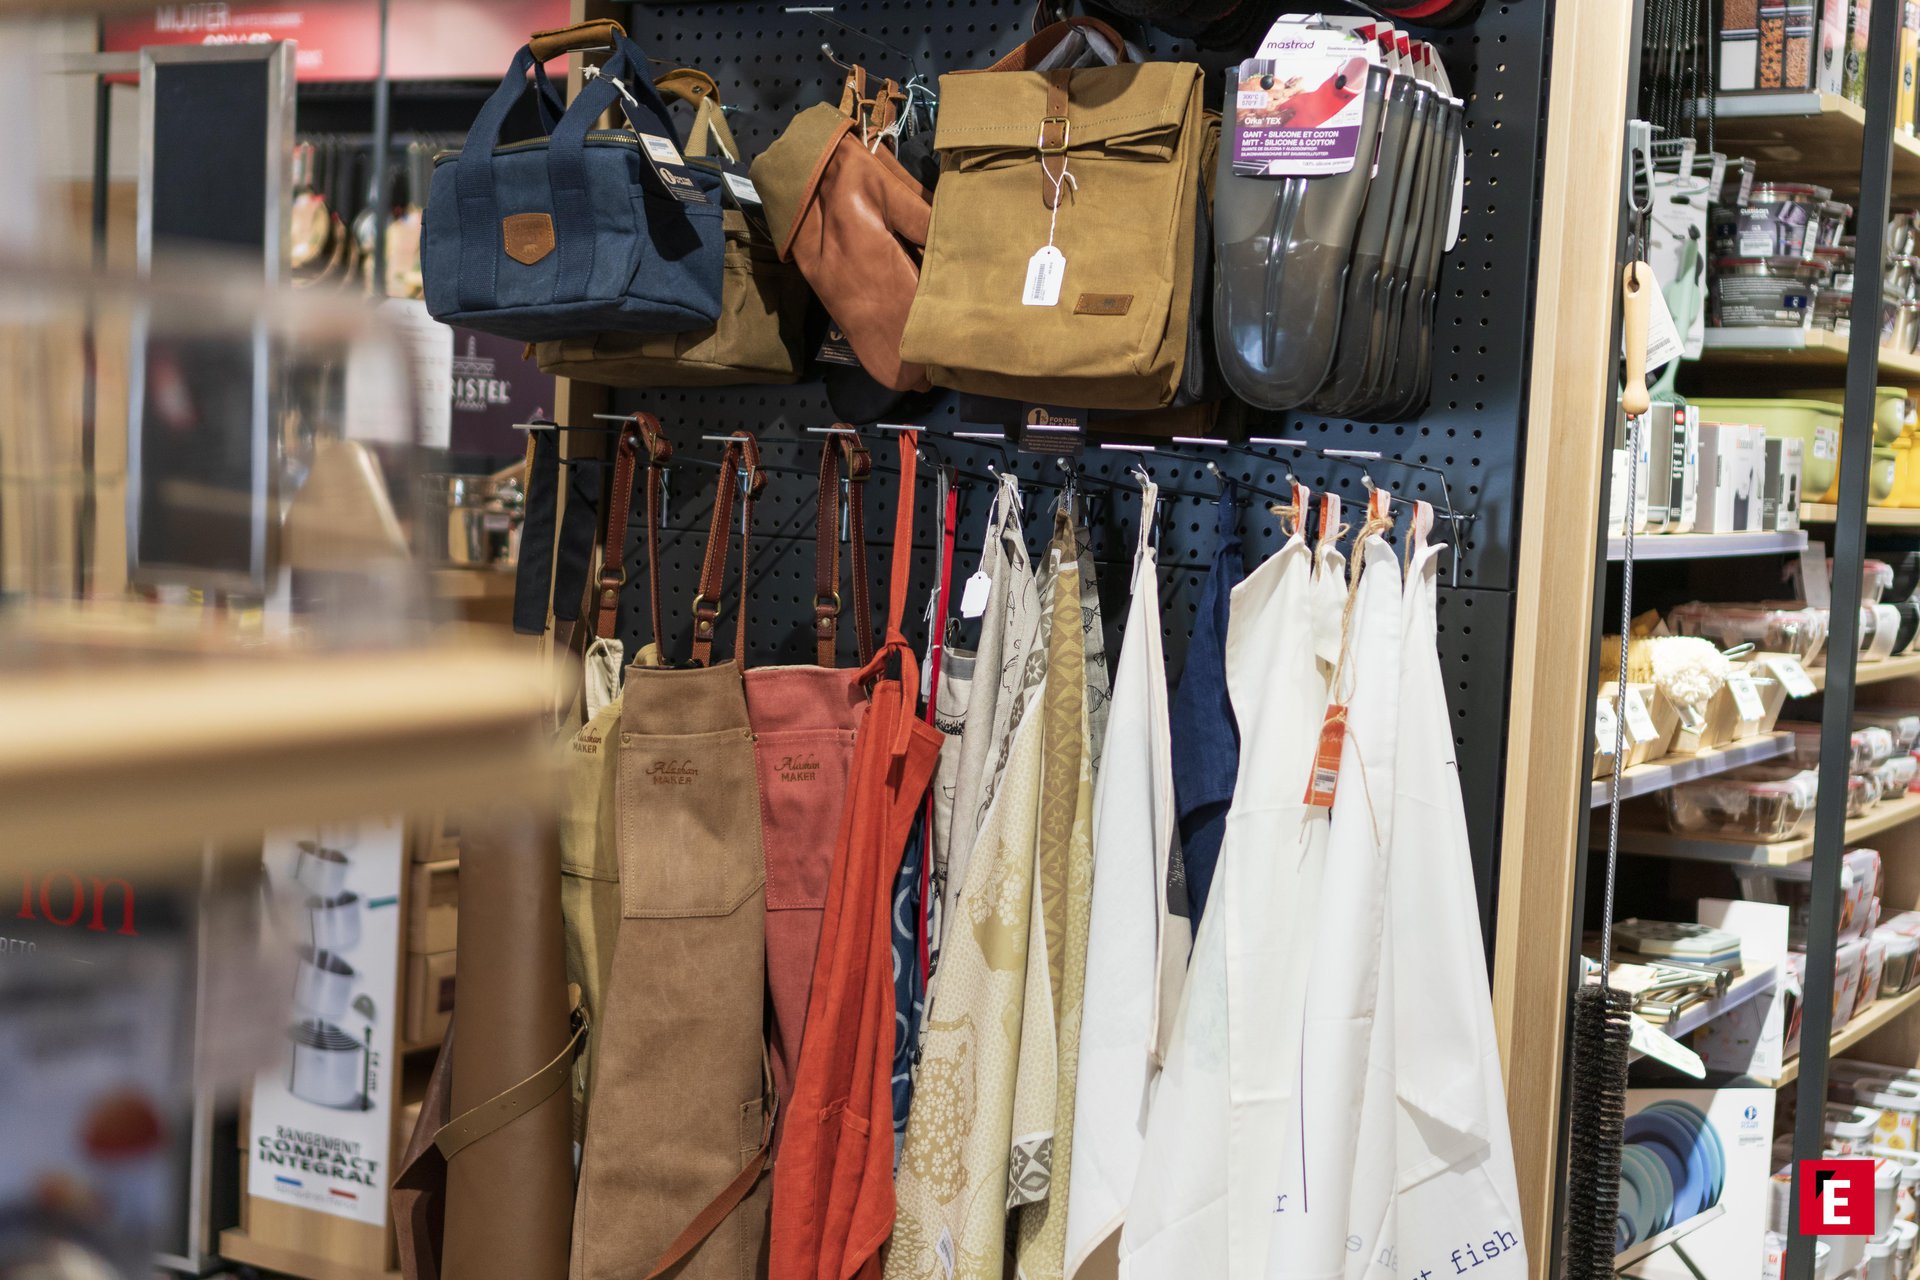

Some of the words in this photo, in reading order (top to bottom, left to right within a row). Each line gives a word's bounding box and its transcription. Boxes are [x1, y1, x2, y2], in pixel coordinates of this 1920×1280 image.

[1266, 40, 1315, 49] mastrad
[1266, 117, 1281, 125] TEX
[653, 776, 692, 785] MAKER
[781, 772, 816, 782] MAKER
[276, 1125, 361, 1154] RANGEMENT
[258, 1136, 379, 1174] COMPACT
[1451, 1230, 1518, 1275] fish
